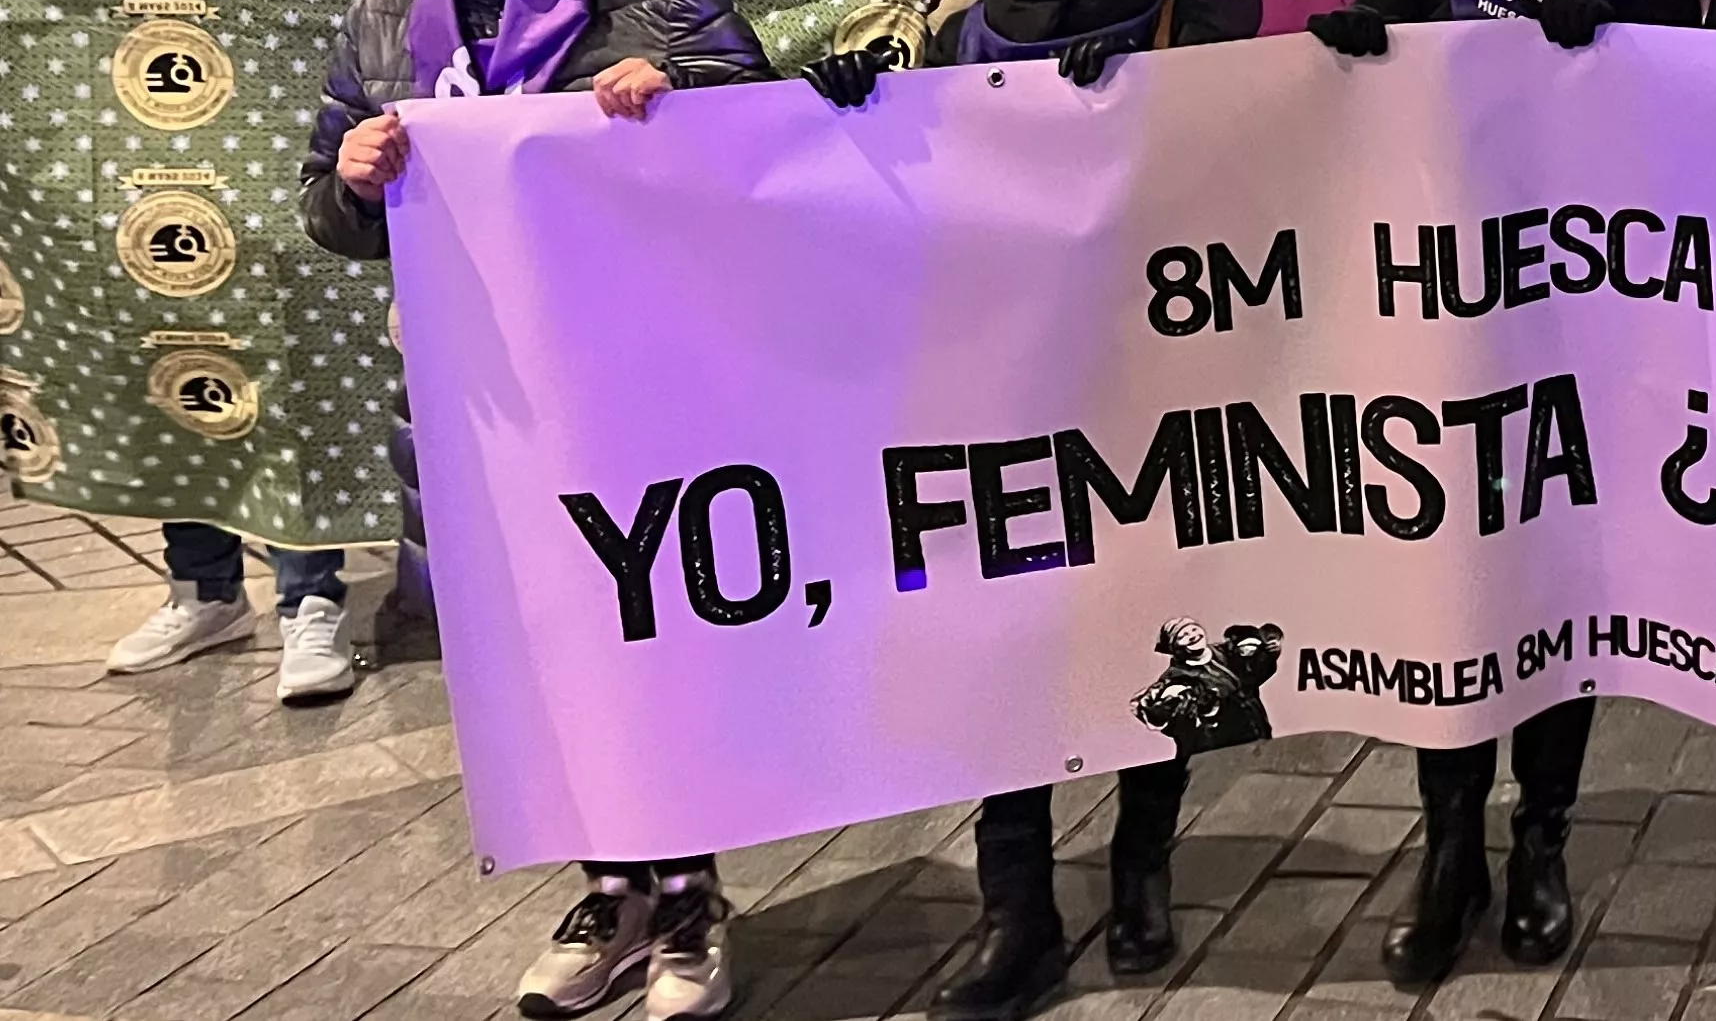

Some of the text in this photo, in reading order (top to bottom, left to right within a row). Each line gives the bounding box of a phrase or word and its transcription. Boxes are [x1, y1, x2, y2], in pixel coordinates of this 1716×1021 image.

[1146, 204, 1715, 337] 8M HUESCA
[558, 463, 832, 643] YO,
[882, 373, 1598, 593] FEMINISTA
[1297, 647, 1504, 707] ASAMBLEA
[1516, 619, 1574, 682] 8M
